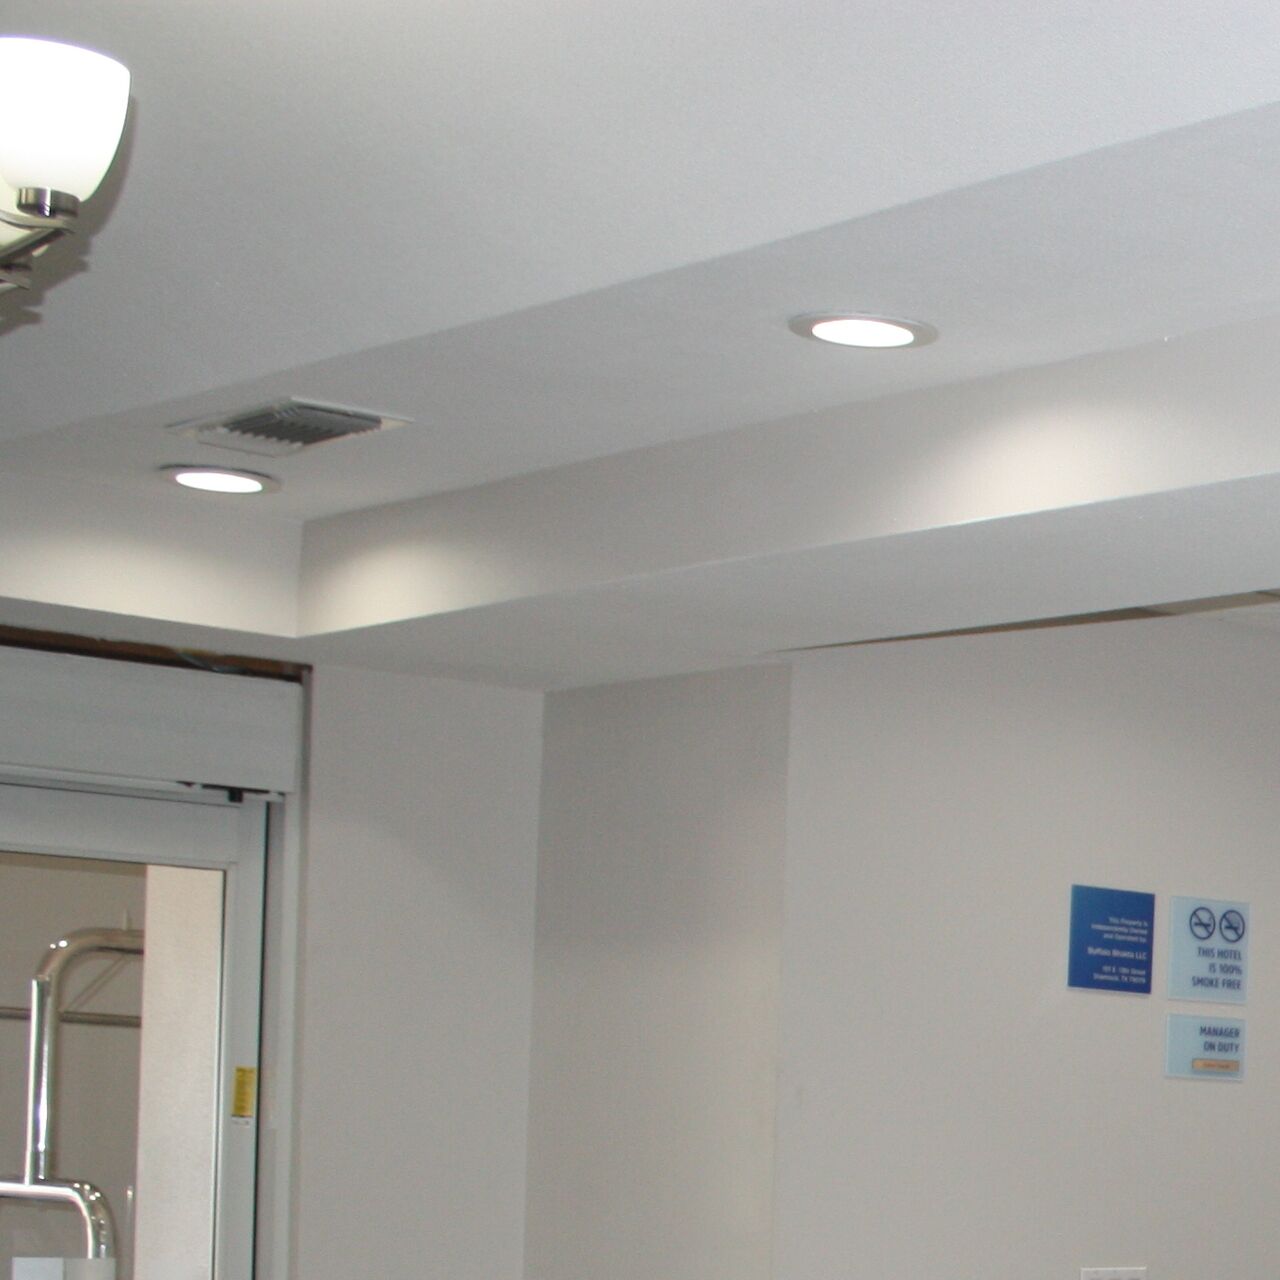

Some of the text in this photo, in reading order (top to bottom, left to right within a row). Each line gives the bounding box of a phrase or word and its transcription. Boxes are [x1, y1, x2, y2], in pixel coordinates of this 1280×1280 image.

[1198, 947, 1242, 960] THIS HOTEL
[1208, 963, 1242, 975] IS 100%
[1192, 976, 1241, 990] SMOKE FREE
[1200, 1026, 1240, 1038] MANAGER
[1203, 1041, 1240, 1053] ON DUTY
